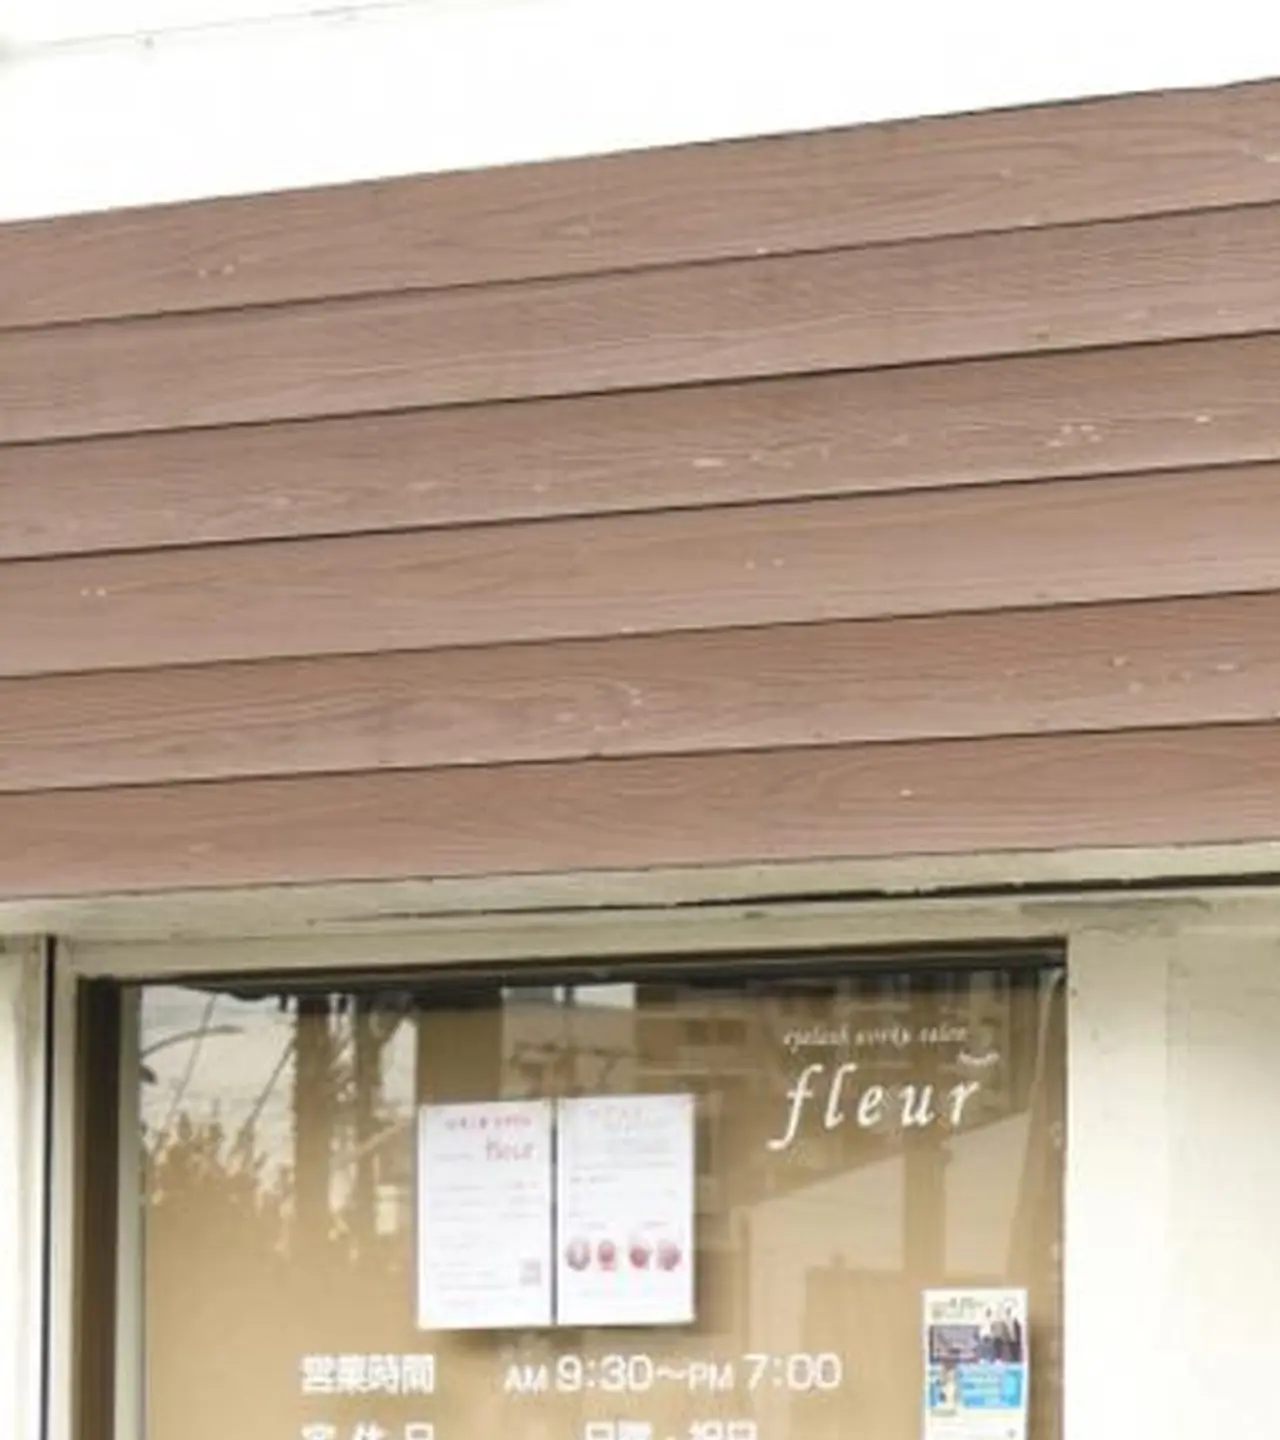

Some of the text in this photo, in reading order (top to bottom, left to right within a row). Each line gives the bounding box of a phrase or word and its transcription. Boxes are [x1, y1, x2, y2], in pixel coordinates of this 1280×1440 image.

[766, 1062, 981, 1150] fleur
[300, 1353, 436, 1395] 営業時間
[743, 1352, 843, 1391] 7:00
